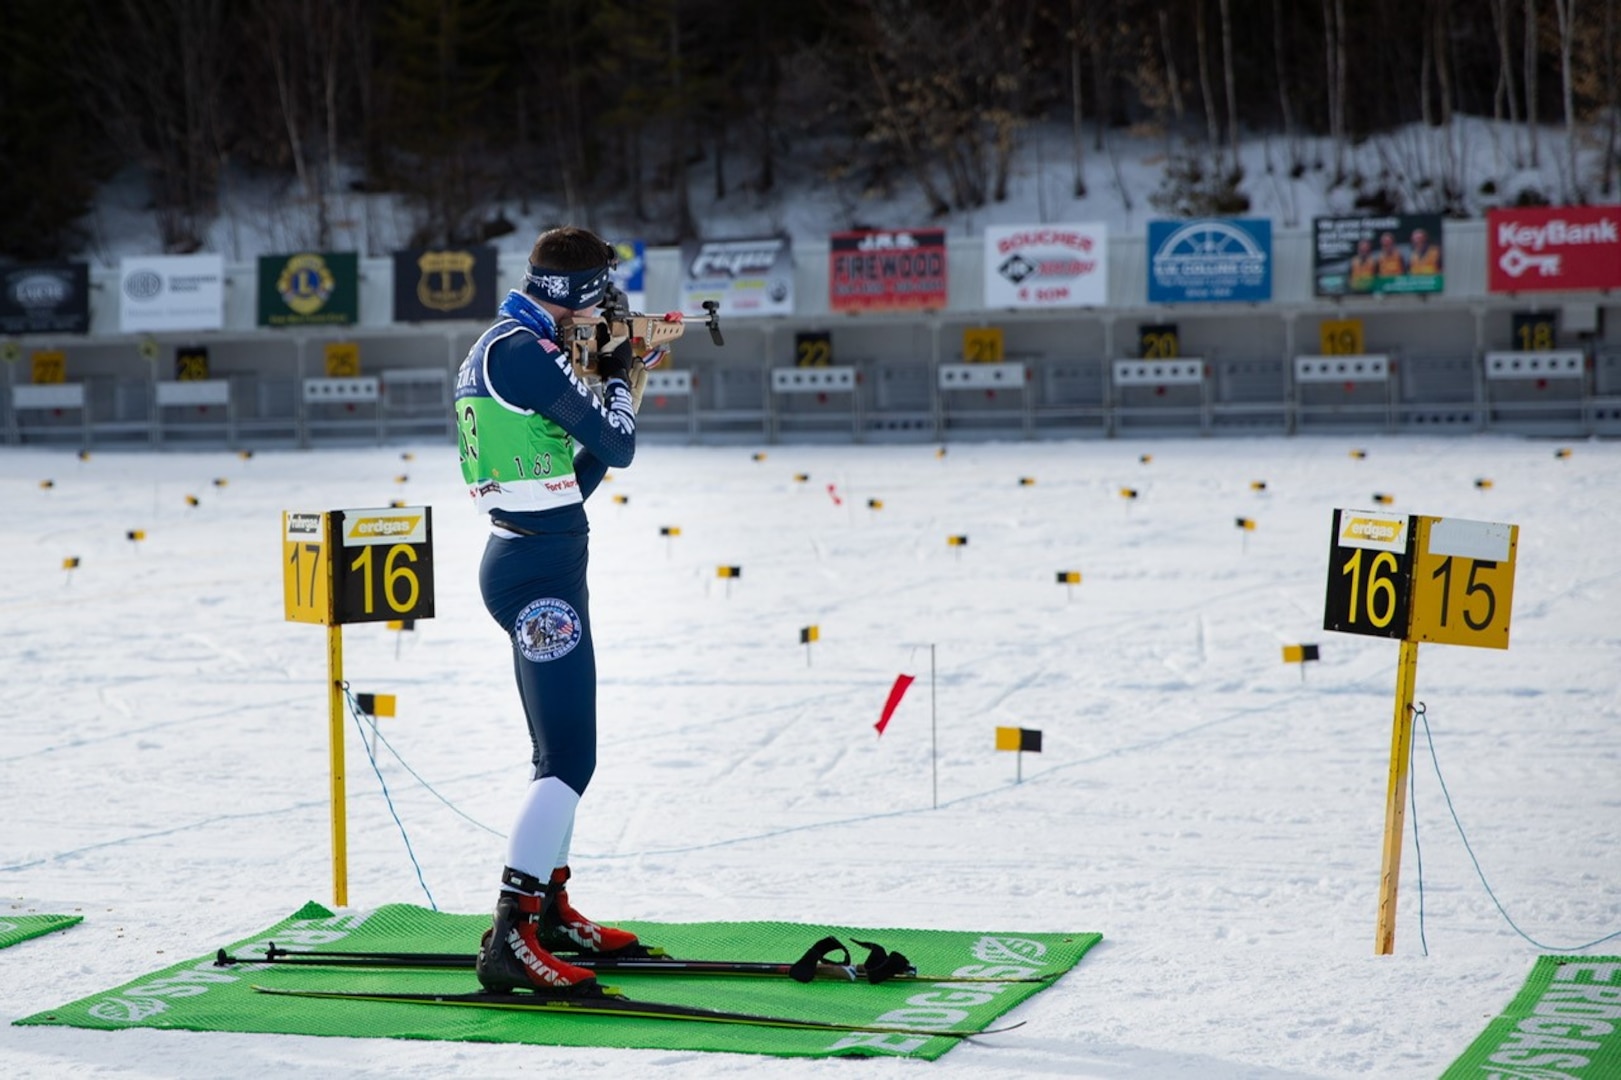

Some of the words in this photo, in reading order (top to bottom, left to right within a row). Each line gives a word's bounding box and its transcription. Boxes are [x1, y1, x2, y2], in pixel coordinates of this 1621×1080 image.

[997, 229, 1095, 254] BOUCHER
[1498, 217, 1619, 251] KeyBank
[835, 252, 942, 280] FIREWOOD
[1143, 332, 1177, 359] 20
[1326, 330, 1355, 355] 19
[1519, 322, 1554, 351] 18
[799, 340, 830, 367] 22
[970, 338, 998, 363] 21
[358, 518, 410, 534] erdgas
[1350, 522, 1395, 538] erdgas
[290, 543, 321, 608] 17
[350, 543, 420, 614] 16
[1342, 548, 1399, 629] 16
[1432, 556, 1498, 632] 15
